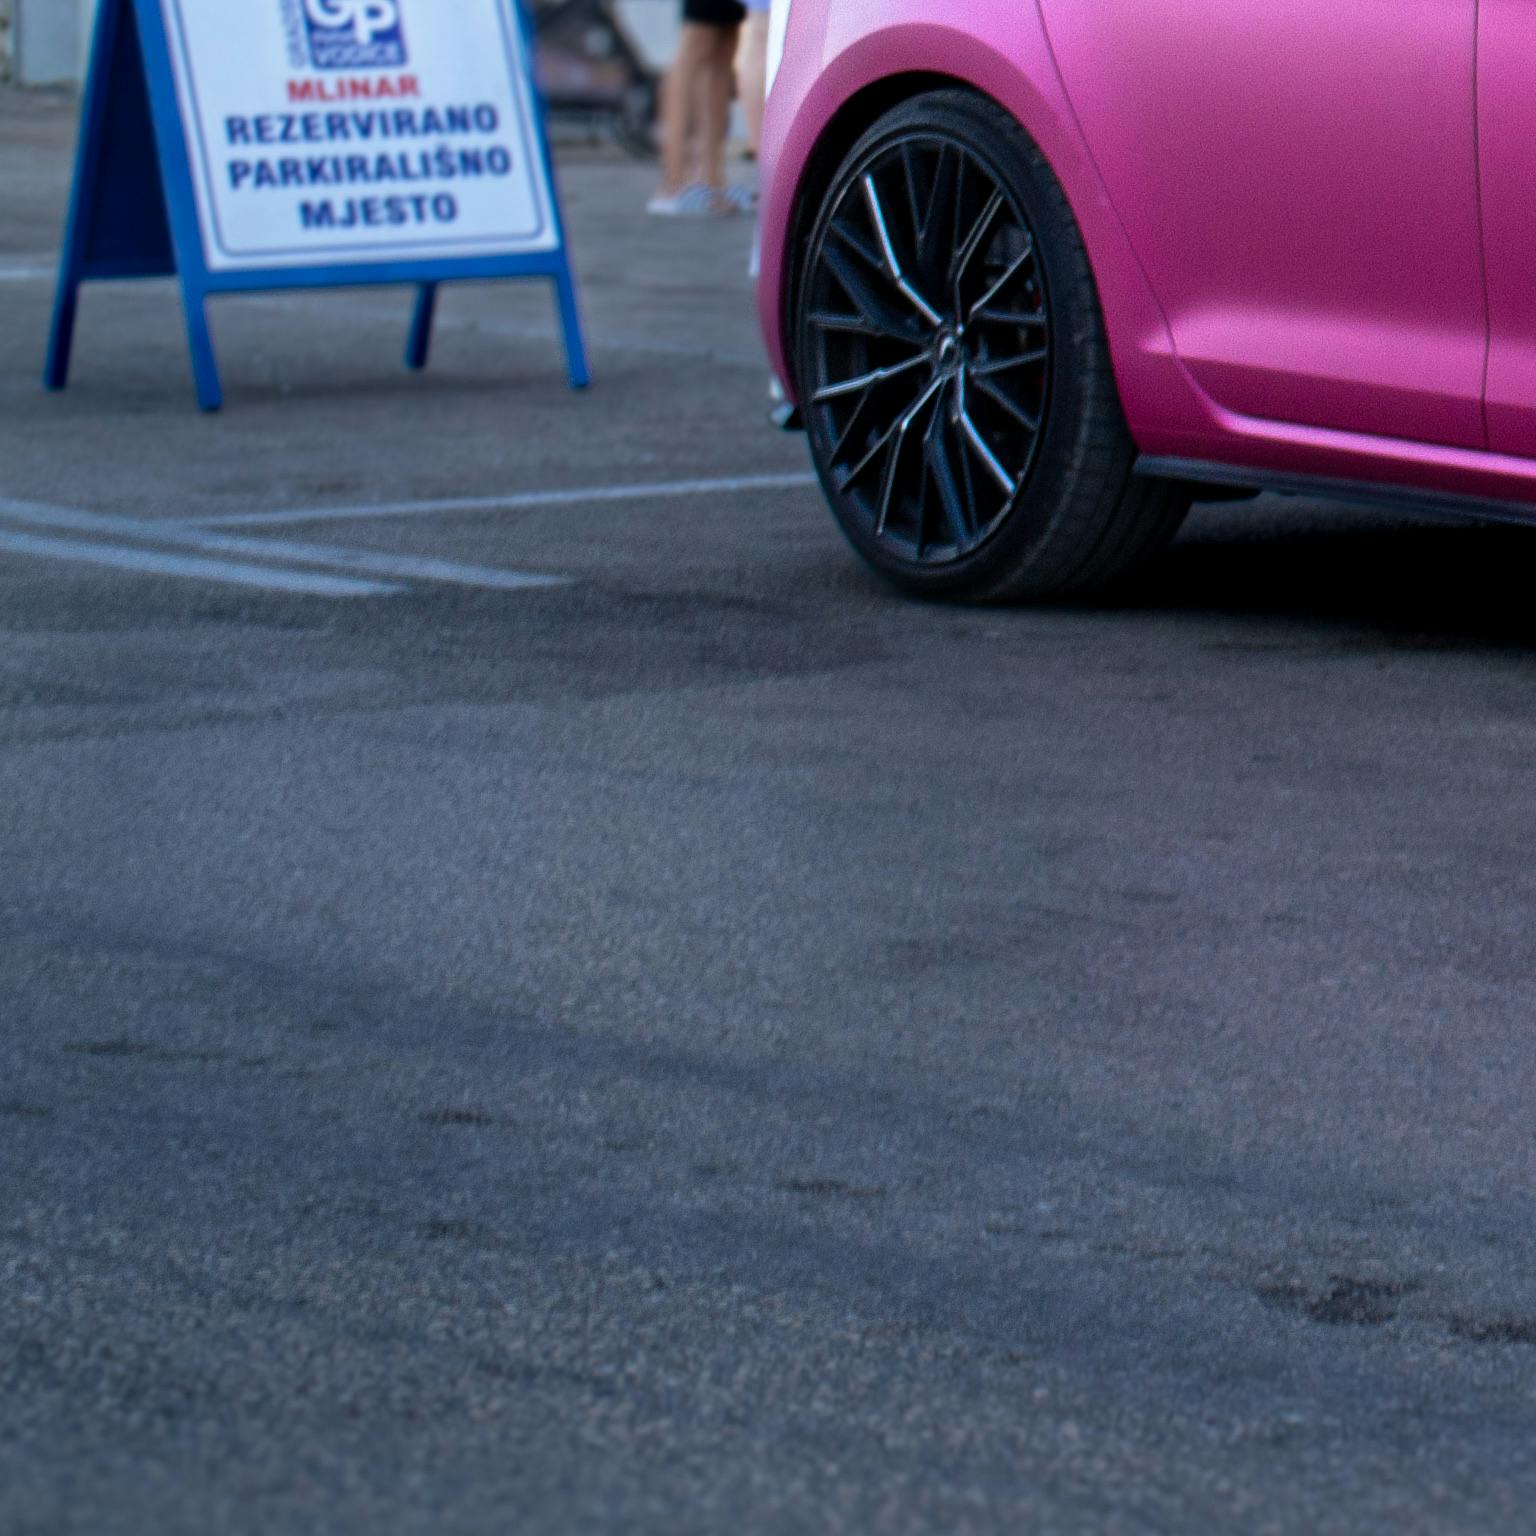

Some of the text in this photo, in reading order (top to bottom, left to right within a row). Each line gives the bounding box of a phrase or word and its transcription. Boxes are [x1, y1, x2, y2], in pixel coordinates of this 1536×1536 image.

[287, 75, 420, 103] MLINAR
[225, 103, 499, 145] REZERVIRANO
[228, 143, 511, 190] PARKIRALIŠNO
[299, 192, 459, 230] MJESTO
